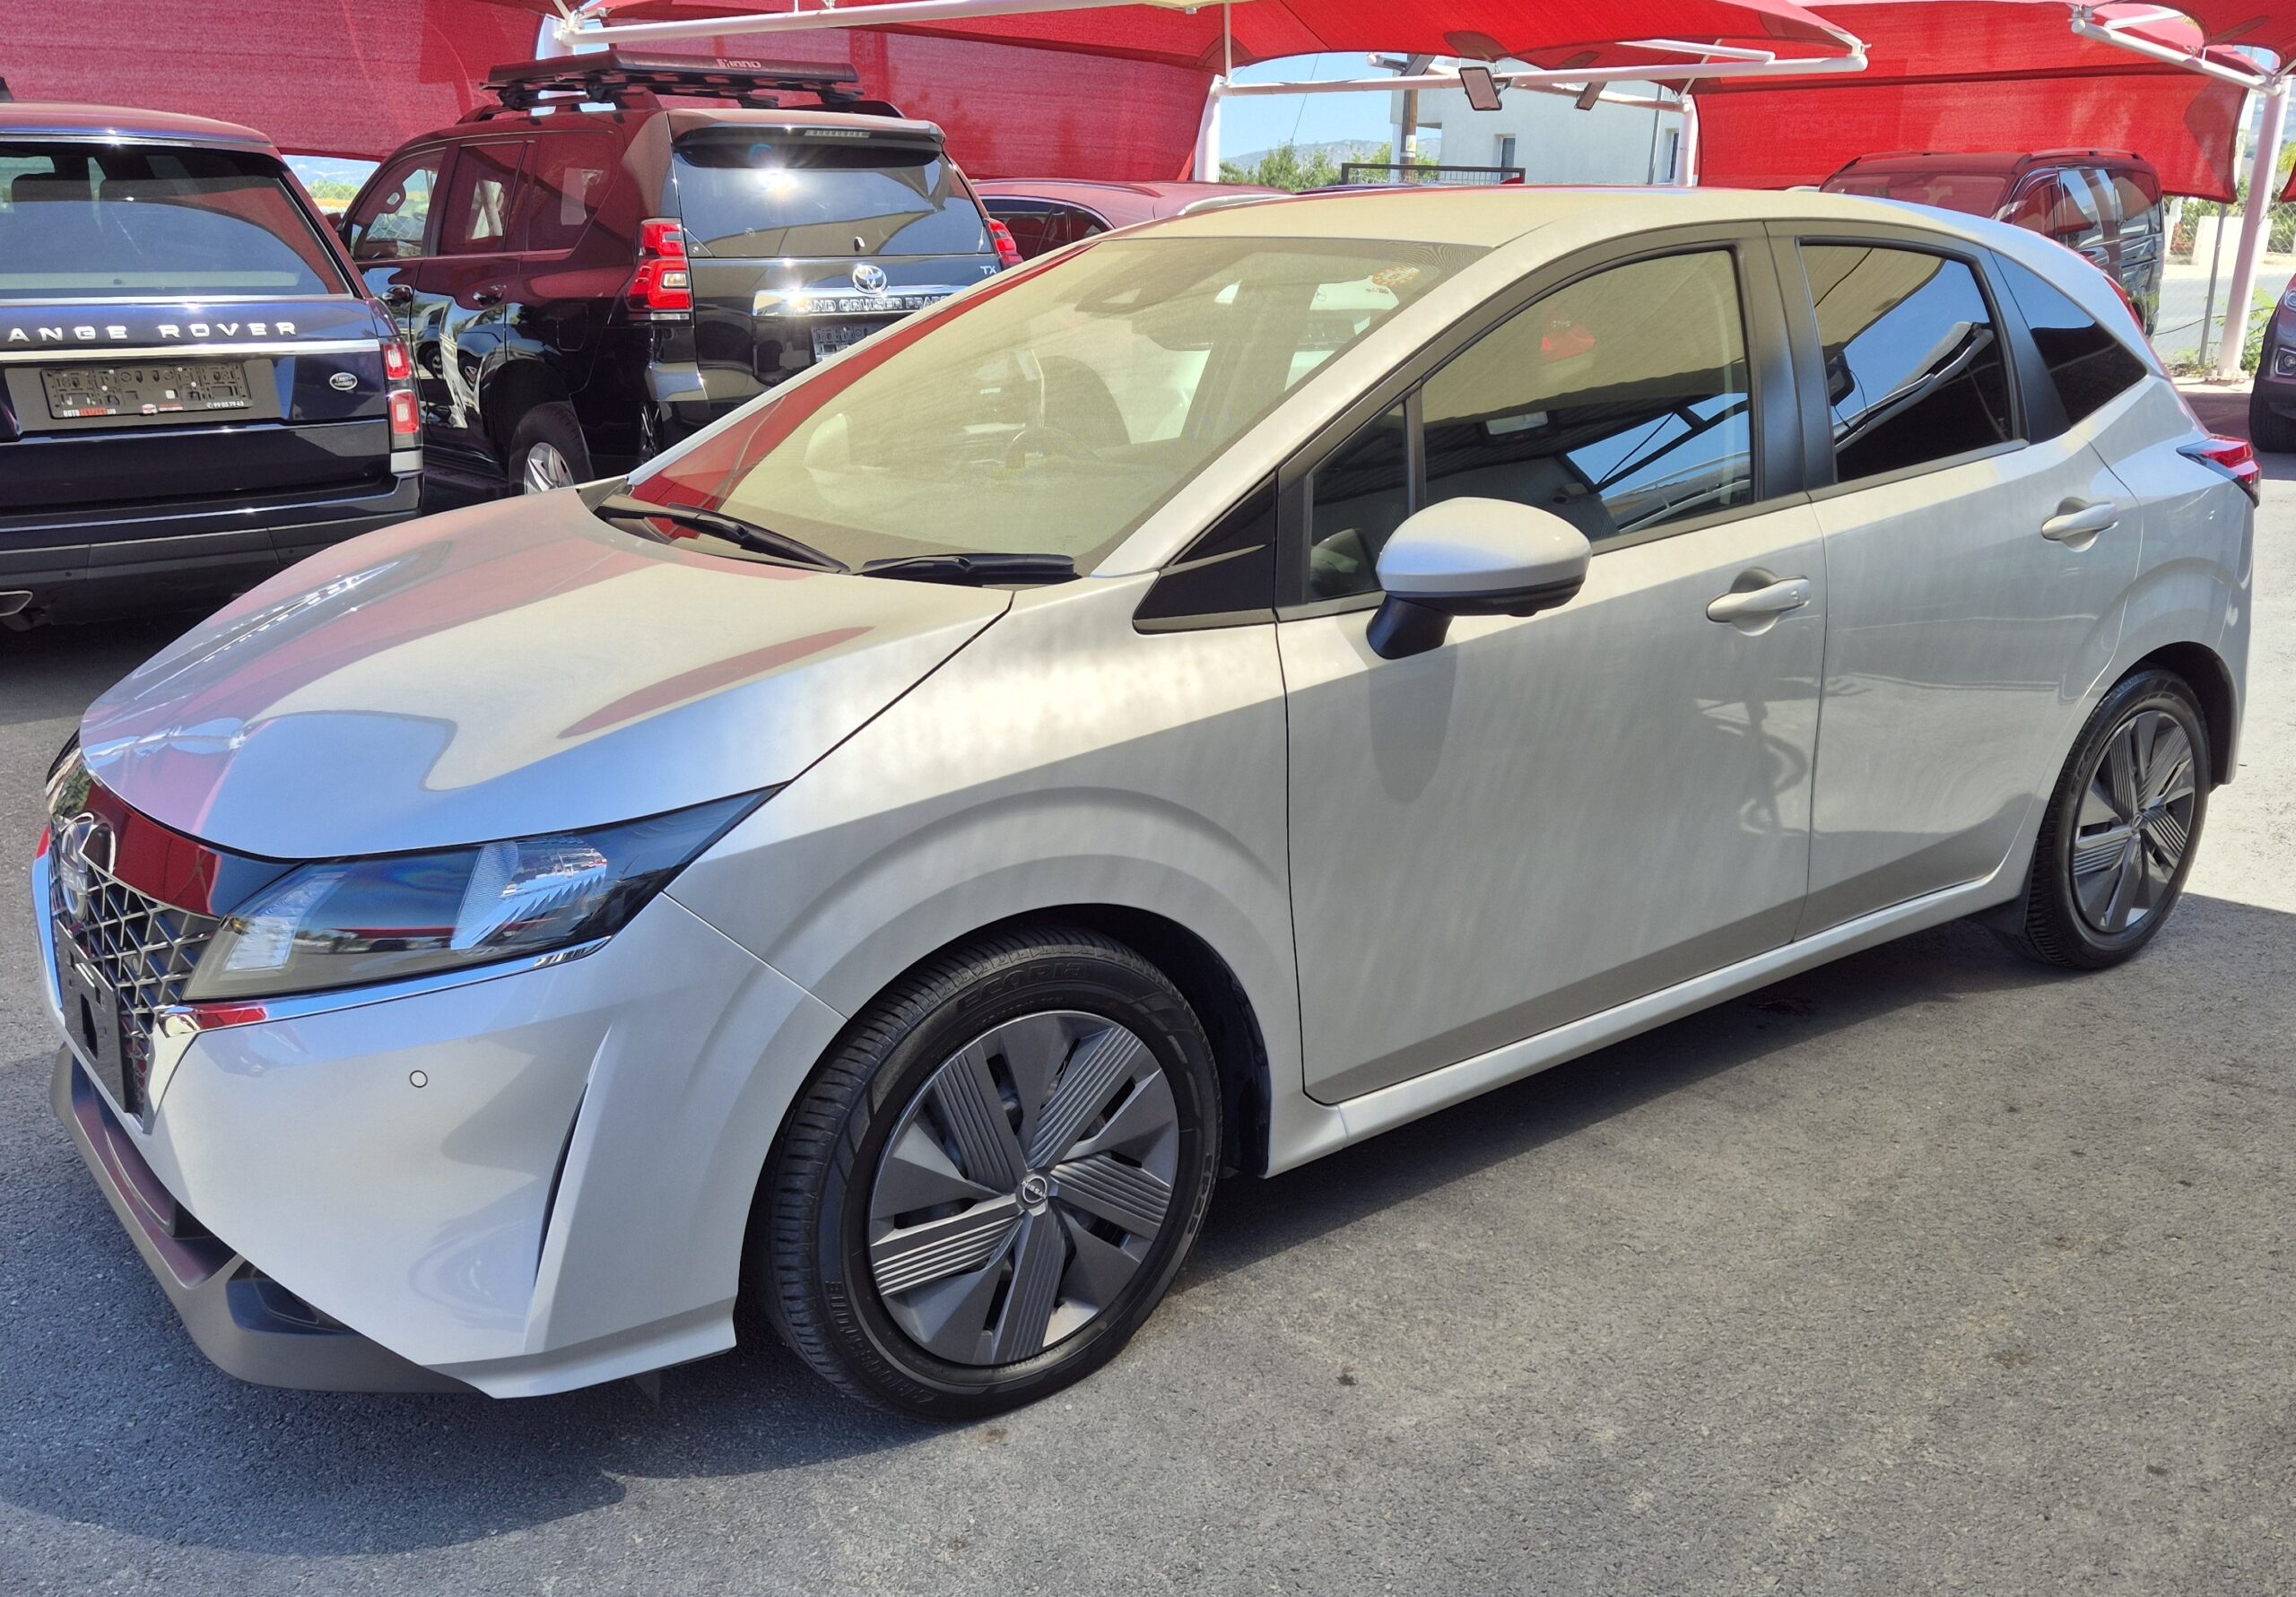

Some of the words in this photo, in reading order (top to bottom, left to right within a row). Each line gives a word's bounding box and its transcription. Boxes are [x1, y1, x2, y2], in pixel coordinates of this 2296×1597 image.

[979, 265, 996, 274] TX
[839, 296, 904, 313] CRUISER
[904, 295, 948, 311] PRA
[157, 322, 297, 338] ROVER
